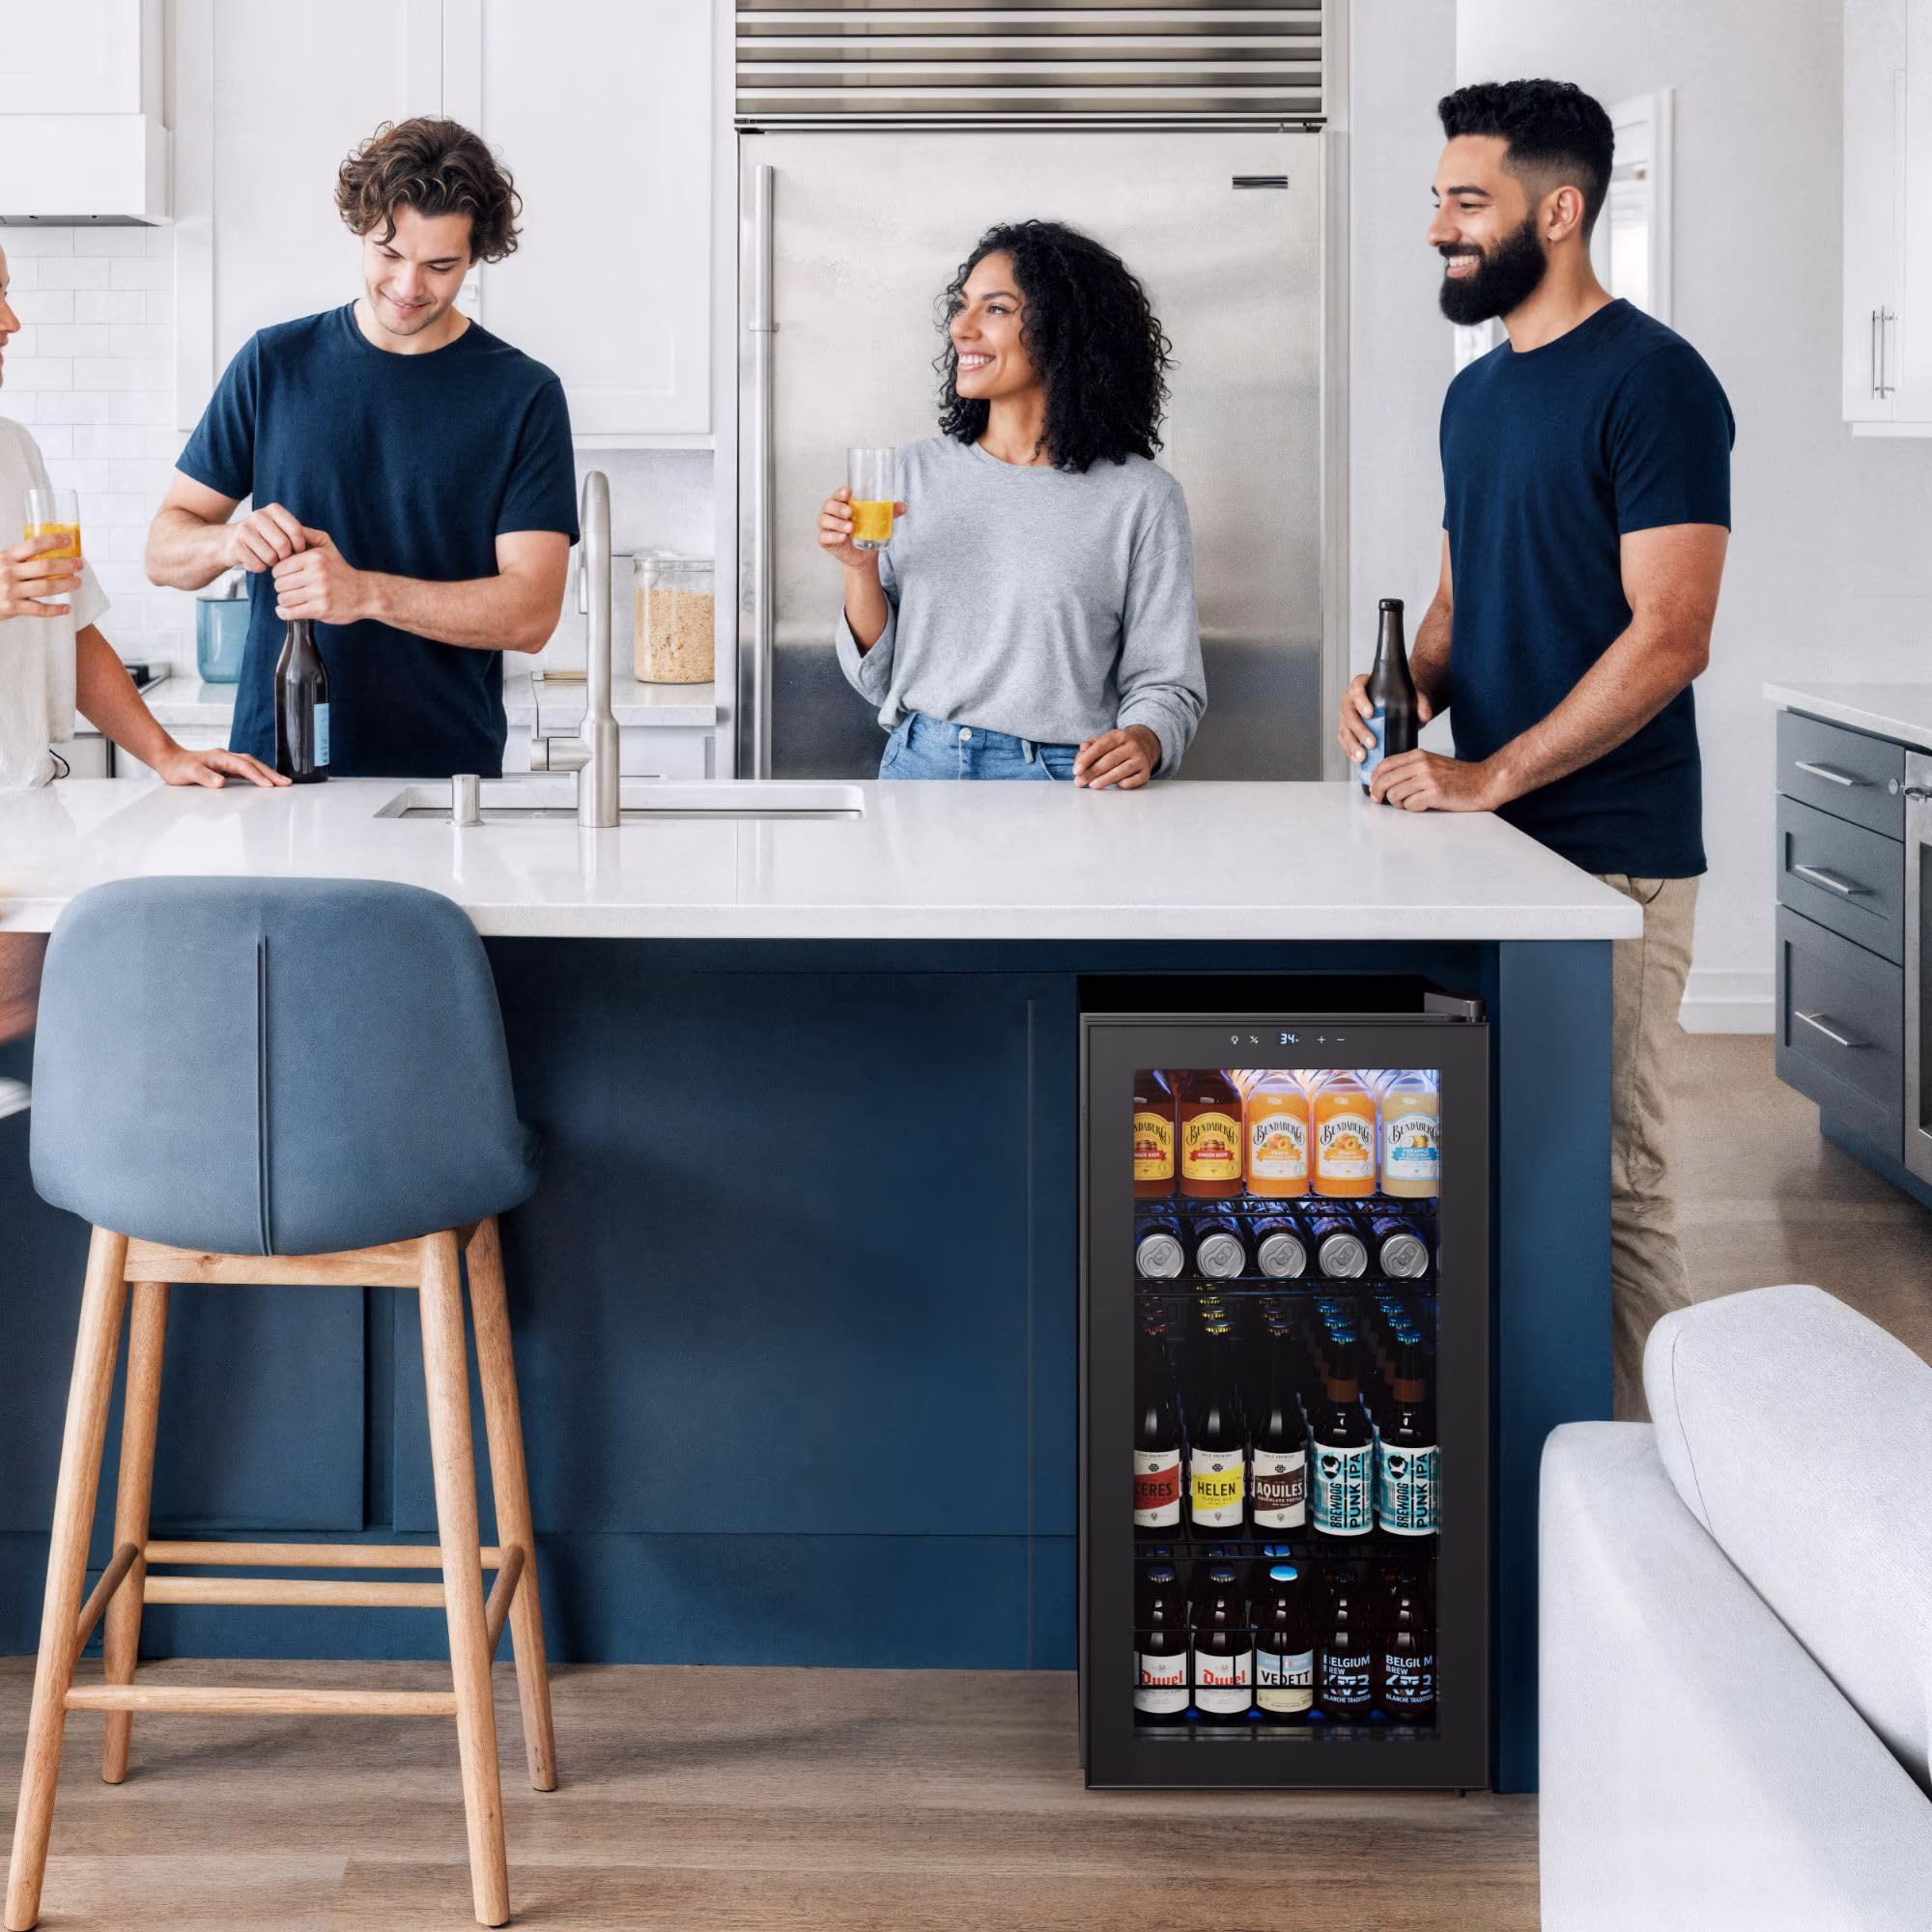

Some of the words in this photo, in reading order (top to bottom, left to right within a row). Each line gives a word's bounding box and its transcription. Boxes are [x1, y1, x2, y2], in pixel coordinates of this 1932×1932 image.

[1186, 1122, 1238, 1146] BUNDABERG
[1253, 1121, 1305, 1146] BUNDABERG
[1321, 1121, 1372, 1146] BUNDABERG
[1388, 1121, 1437, 1146] BUNDABERG
[1349, 1453, 1361, 1479] IPA
[1416, 1453, 1428, 1479] IPA
[1135, 1482, 1174, 1496] CERES
[1197, 1481, 1236, 1496] HELEN
[1256, 1481, 1303, 1497] AQUILES
[1329, 1482, 1343, 1528] BREWDOG
[1350, 1483, 1361, 1528] PUNK
[1396, 1482, 1409, 1528] BREWDOG
[1416, 1483, 1428, 1528] PUNK
[1323, 1654, 1371, 1668] BELGIUM
[1385, 1664, 1408, 1675] BREW
[1261, 1670, 1311, 1686] VEDETT
